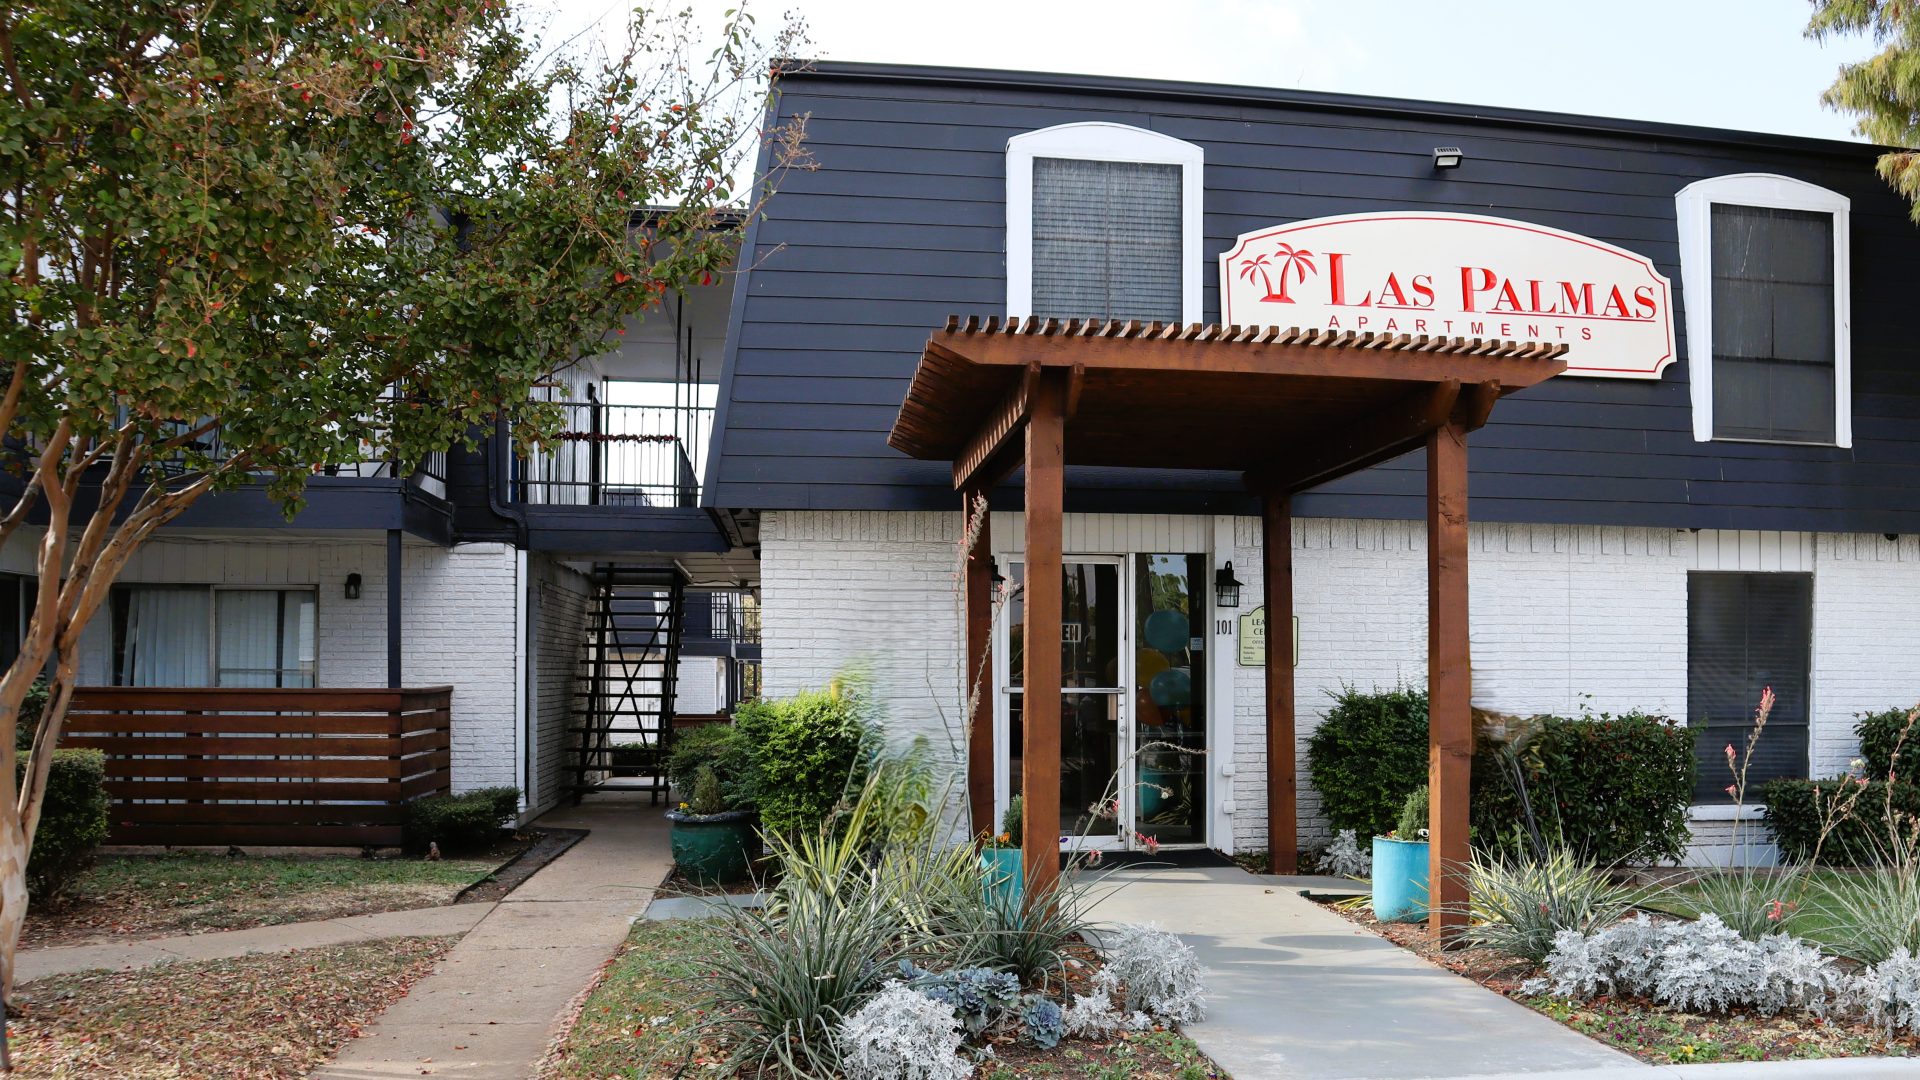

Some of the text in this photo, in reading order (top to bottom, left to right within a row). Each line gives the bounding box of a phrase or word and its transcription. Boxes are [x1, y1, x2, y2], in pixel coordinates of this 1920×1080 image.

[1321, 252, 1657, 319] LAS PALMAS
[1328, 315, 1592, 341] APARTMENTS
[1216, 619, 1232, 635] 101
[1253, 627, 1265, 636] CE
